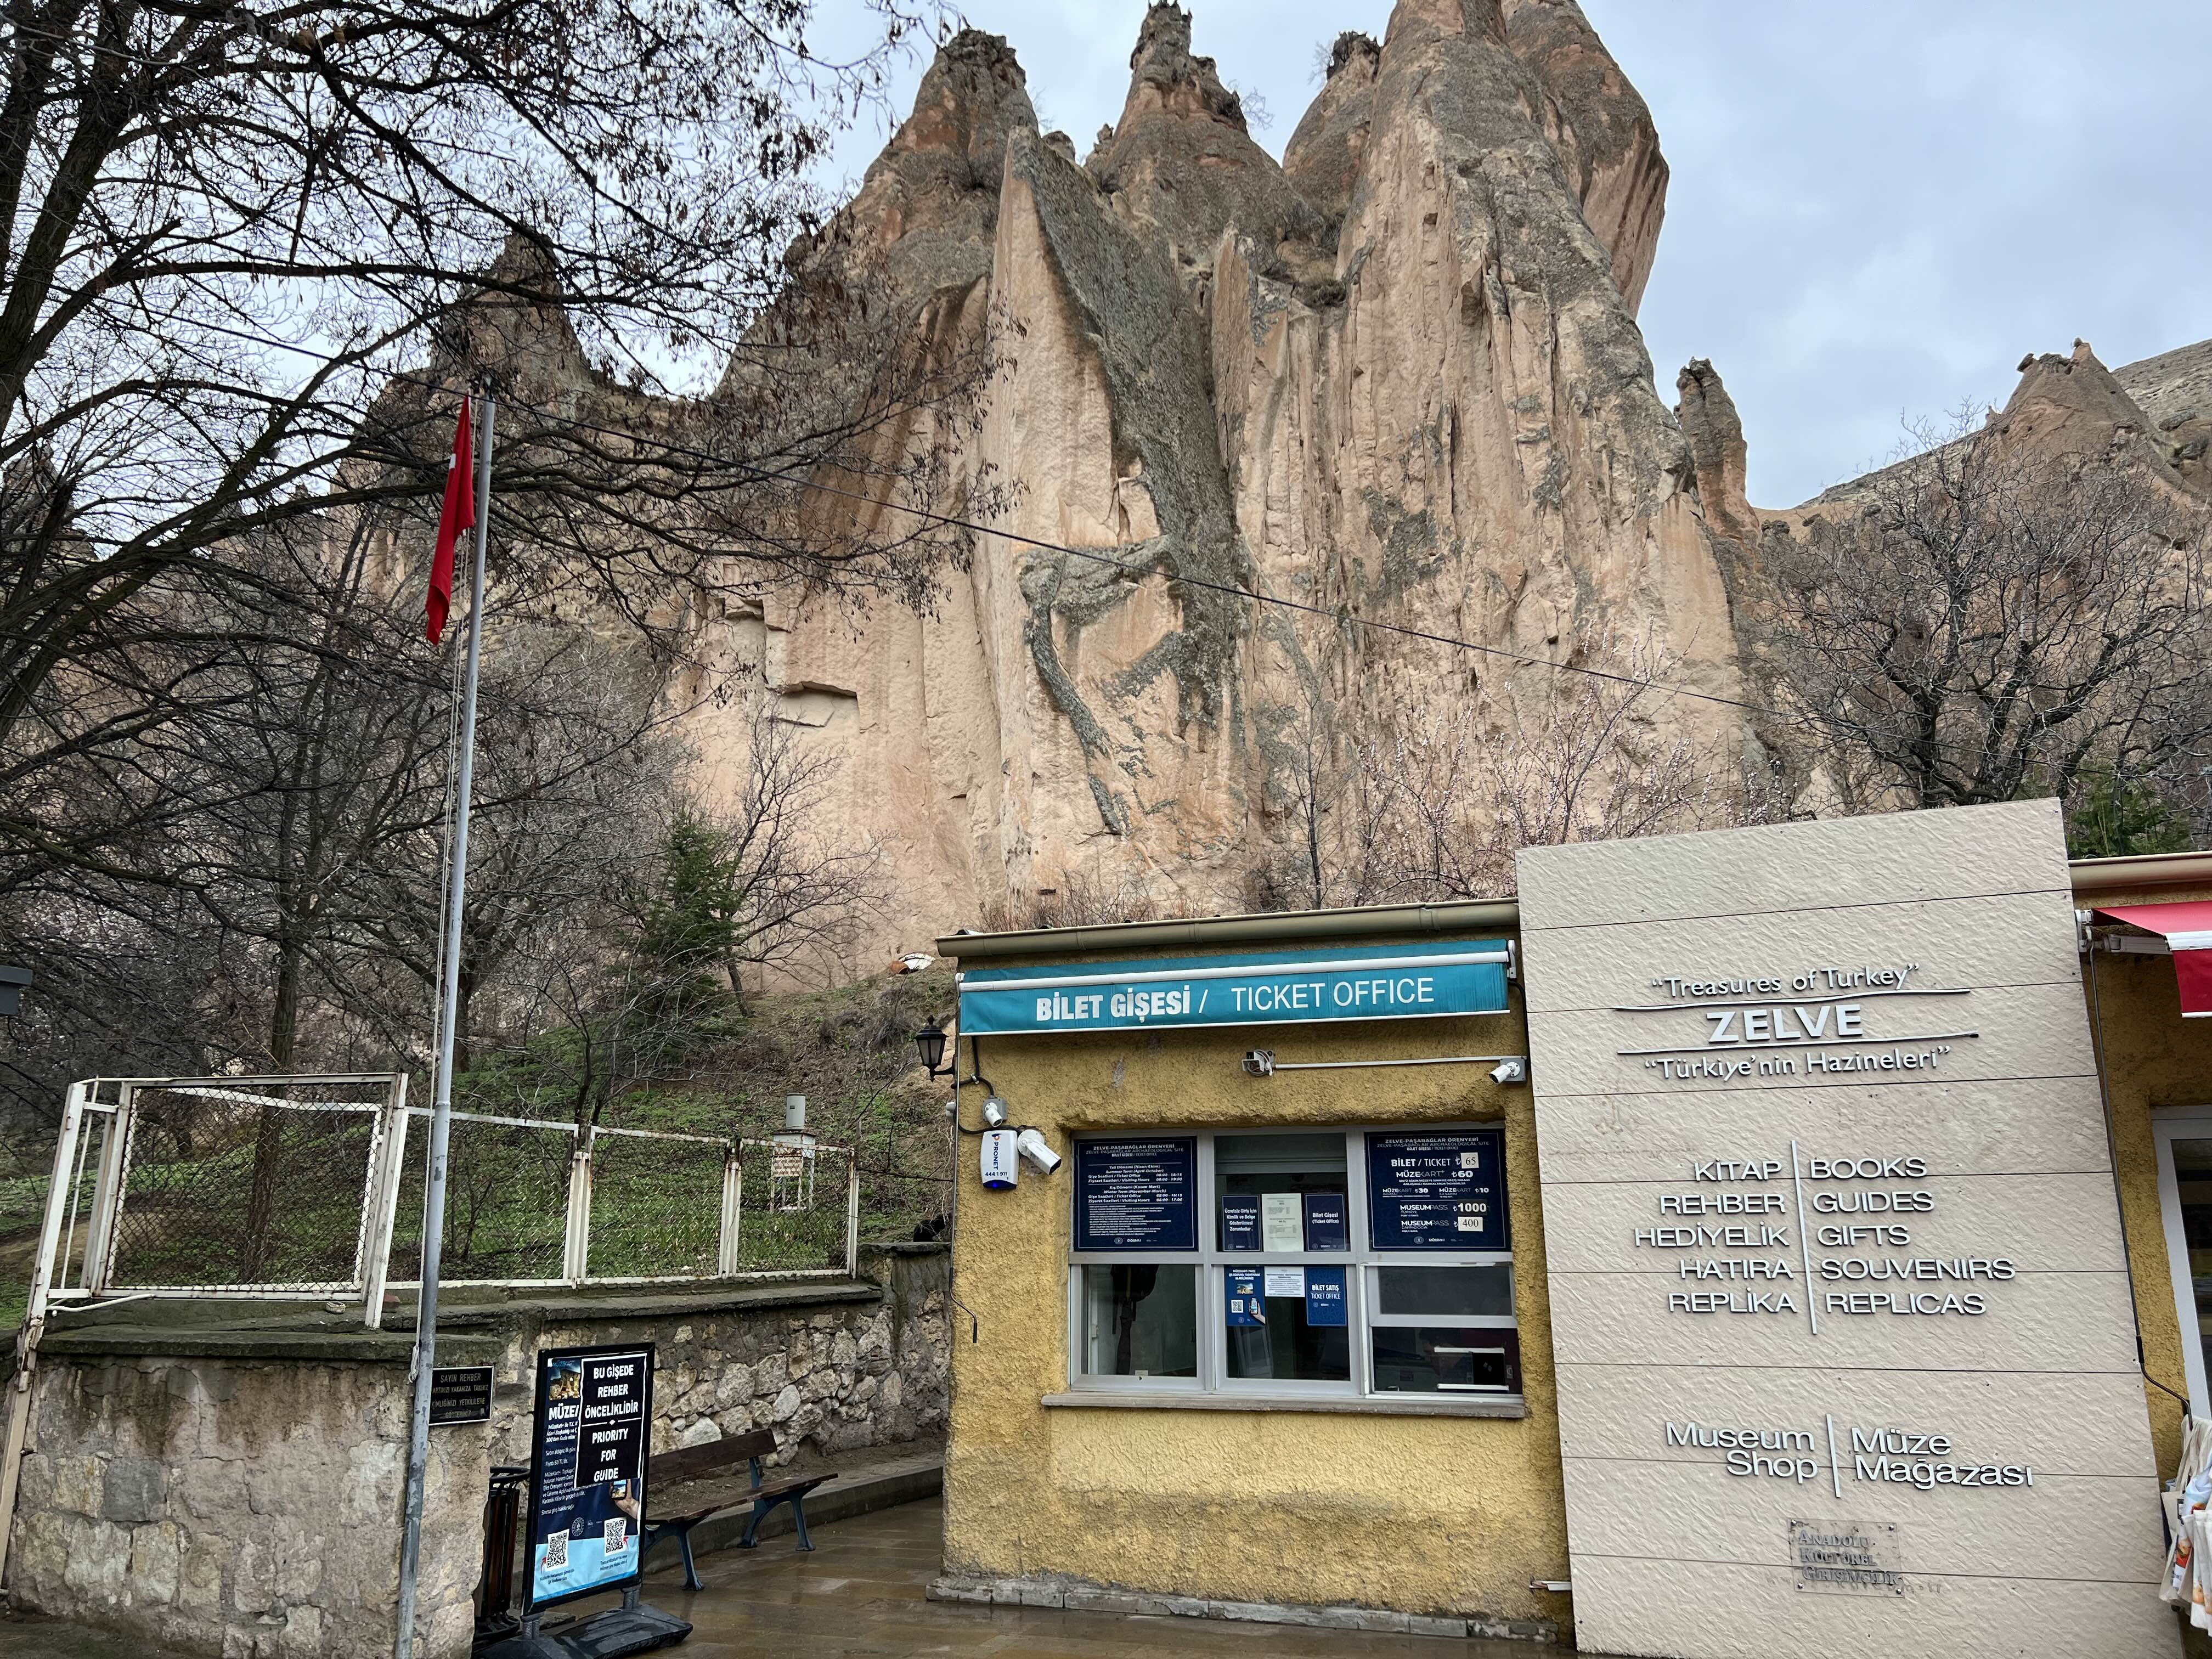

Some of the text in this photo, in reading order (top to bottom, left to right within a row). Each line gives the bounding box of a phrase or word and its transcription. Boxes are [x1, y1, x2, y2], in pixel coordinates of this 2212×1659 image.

[1791, 969, 1816, 991] of
[1036, 991, 1103, 1022] BİLET
[1110, 985, 1190, 1023] GİŞESİ
[1231, 983, 1326, 1011] TICKET
[1333, 977, 1434, 1007] OFFICE
[1707, 1005, 1863, 1043] ZELVE
[1391, 1158, 1416, 1167] BİLET
[1424, 1158, 1451, 1166] TICKET
[1465, 1156, 1476, 1165] 65
[1694, 1158, 1782, 1182] KİTAP
[1810, 1157, 1928, 1180] BOOKS
[1660, 1193, 1786, 1215] REHBER
[1812, 1190, 1935, 1213] GUIDES
[1462, 1218, 1479, 1227] 400
[1635, 1221, 1790, 1248] HEDİYELİK
[1818, 1224, 1911, 1246] GIFTS
[1680, 1259, 1795, 1280] HATIRA
[1820, 1257, 2017, 1280] SOUVENIRS
[1668, 1287, 1798, 1313] REPLİKA
[1825, 1293, 1987, 1316] REPLICAS
[440, 1373, 482, 1383] SAYIN REHBER
[593, 1363, 634, 1380] BU GİŞEDE
[597, 1384, 629, 1398] REHBER
[584, 1400, 639, 1419] ÖNCELİKLİDİR
[592, 1428, 629, 1444] PRIORITY
[1666, 1421, 1815, 1451] Museum
[1851, 1426, 1952, 1457] Müze
[601, 1449, 617, 1462] FOR
[594, 1467, 619, 1482] GUIDE
[1725, 1449, 1818, 1485] Shop
[1854, 1453, 2034, 1491] Mağazası
[1798, 1530, 1870, 1548] ANADOLU
